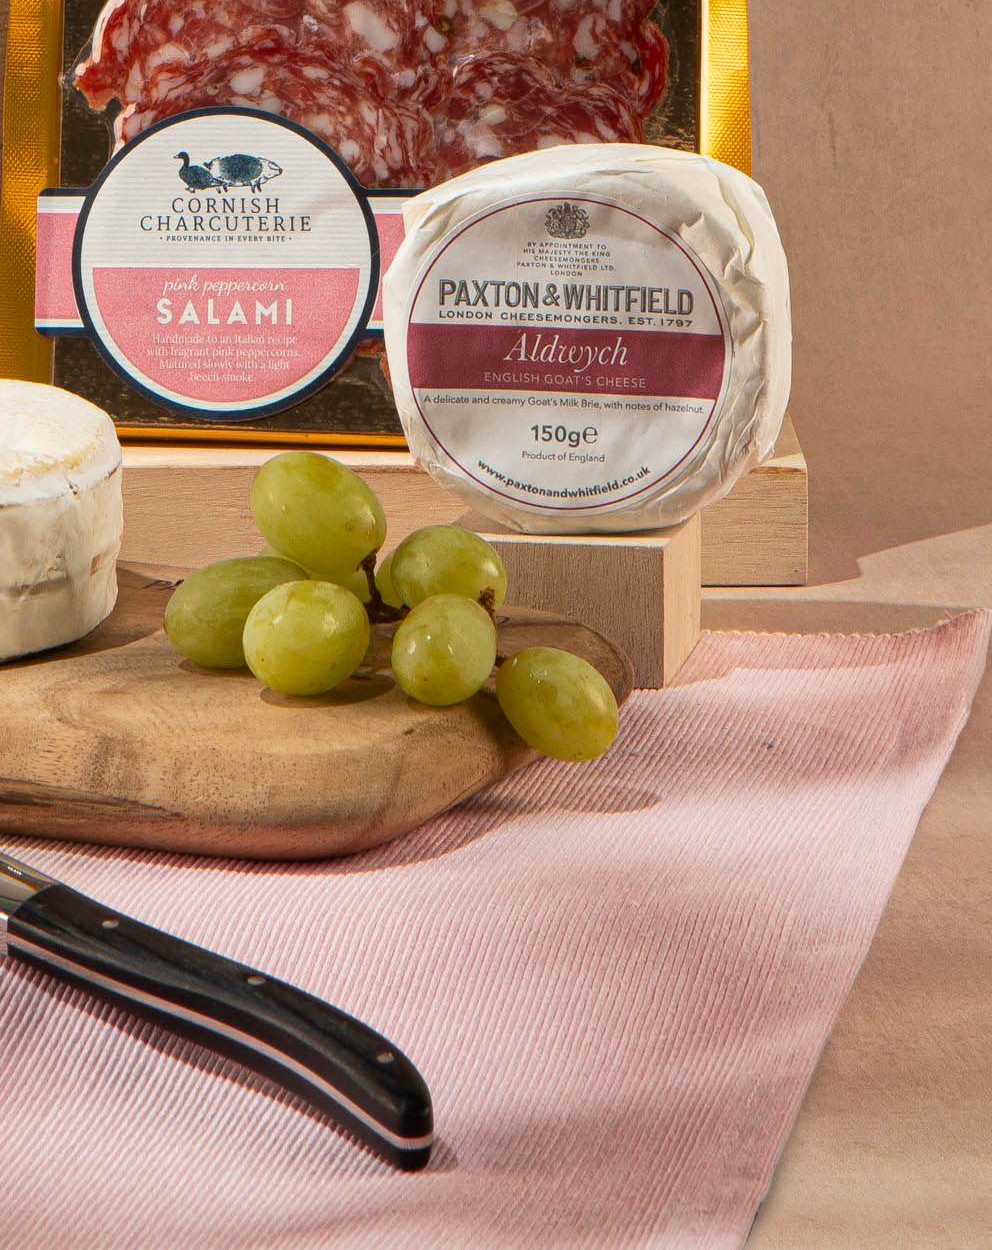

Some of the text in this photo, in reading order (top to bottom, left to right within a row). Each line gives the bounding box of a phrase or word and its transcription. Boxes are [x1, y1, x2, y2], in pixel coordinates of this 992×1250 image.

[172, 198, 280, 213] CORNISH
[140, 215, 312, 232] CHARCUTERIE
[162, 274, 285, 296] pink peppercorn
[157, 298, 293, 325] SALAMI
[439, 310, 693, 328] LONDON CHEESEMONGERS. EST. 1797
[208, 335, 217, 344] to
[147, 347, 167, 357] with
[213, 347, 233, 359] pink
[504, 332, 628, 373] Aldwych
[484, 372, 646, 388] ENGLISH GOAT'S CHEESE
[424, 396, 432, 404] A
[433, 395, 469, 404] delicate
[472, 396, 489, 405] and
[492, 398, 524, 407] creamy
[528, 397, 557, 407] Goat's
[560, 398, 579, 408] Milk
[582, 399, 601, 410] Brie,
[604, 401, 623, 410] with
[626, 402, 651, 411] notes
[653, 402, 664, 411] of
[522, 451, 604, 463] Product of England
[477, 460, 651, 499] www.paxtonandwhitfield.co.uk
